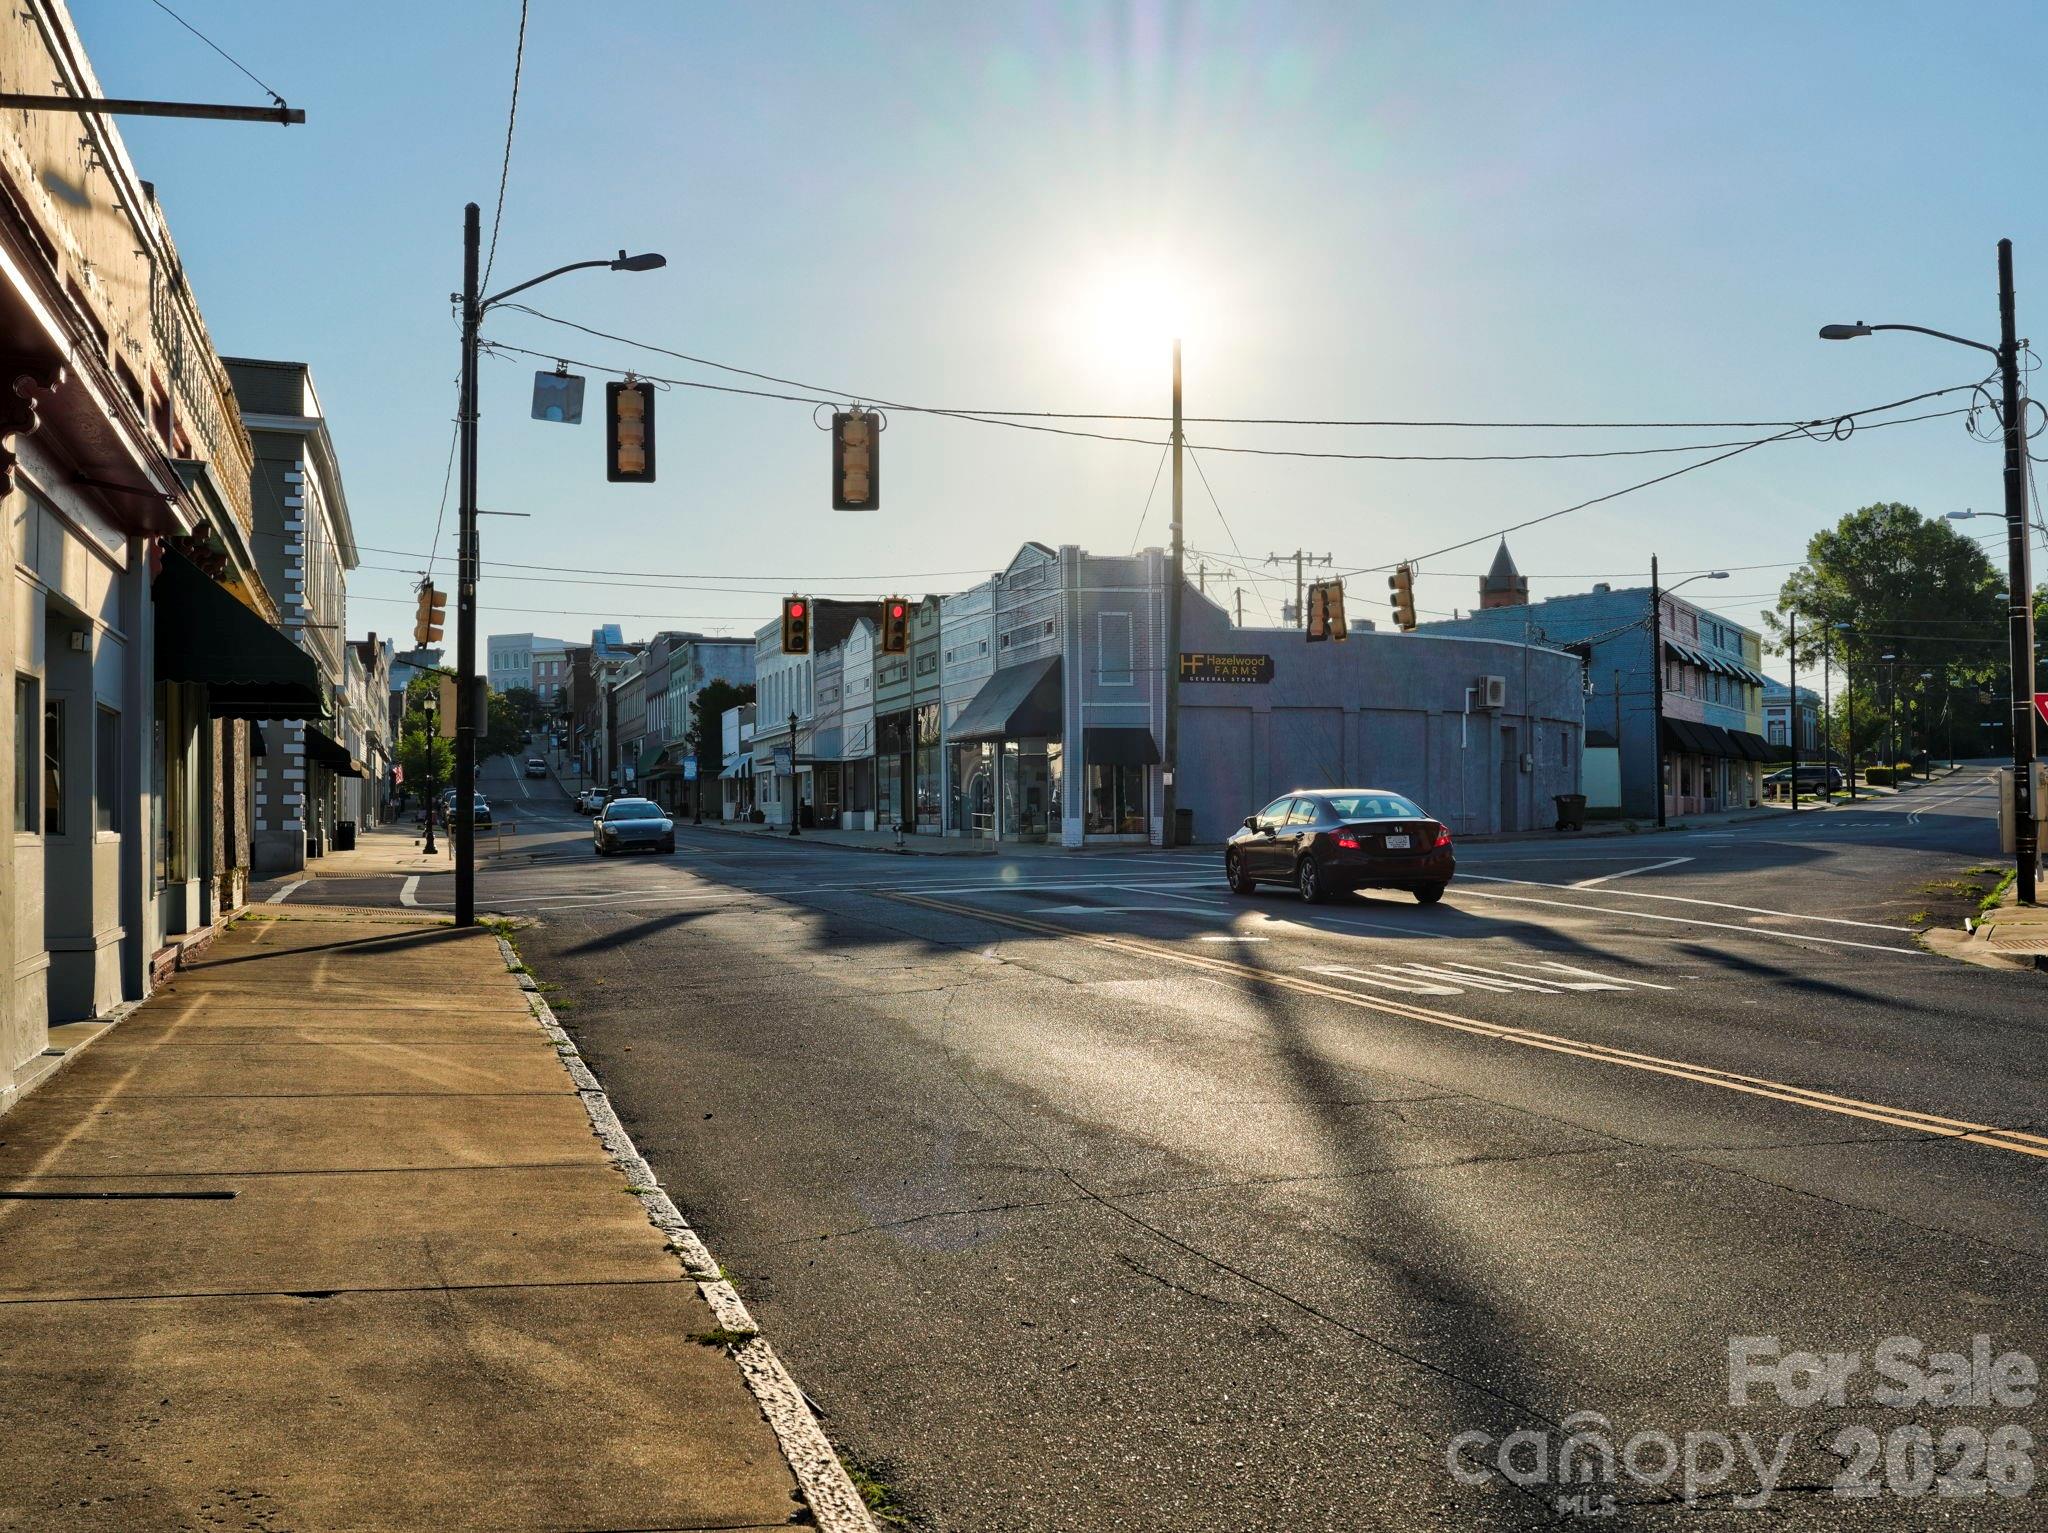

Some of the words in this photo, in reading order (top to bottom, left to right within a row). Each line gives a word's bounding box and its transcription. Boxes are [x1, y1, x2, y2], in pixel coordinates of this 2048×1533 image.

[1180, 654, 1205, 675] HF
[1206, 655, 1265, 666] Hazelwood
[1214, 666, 1258, 675] FARMS
[1299, 961, 1676, 996] ONLY
